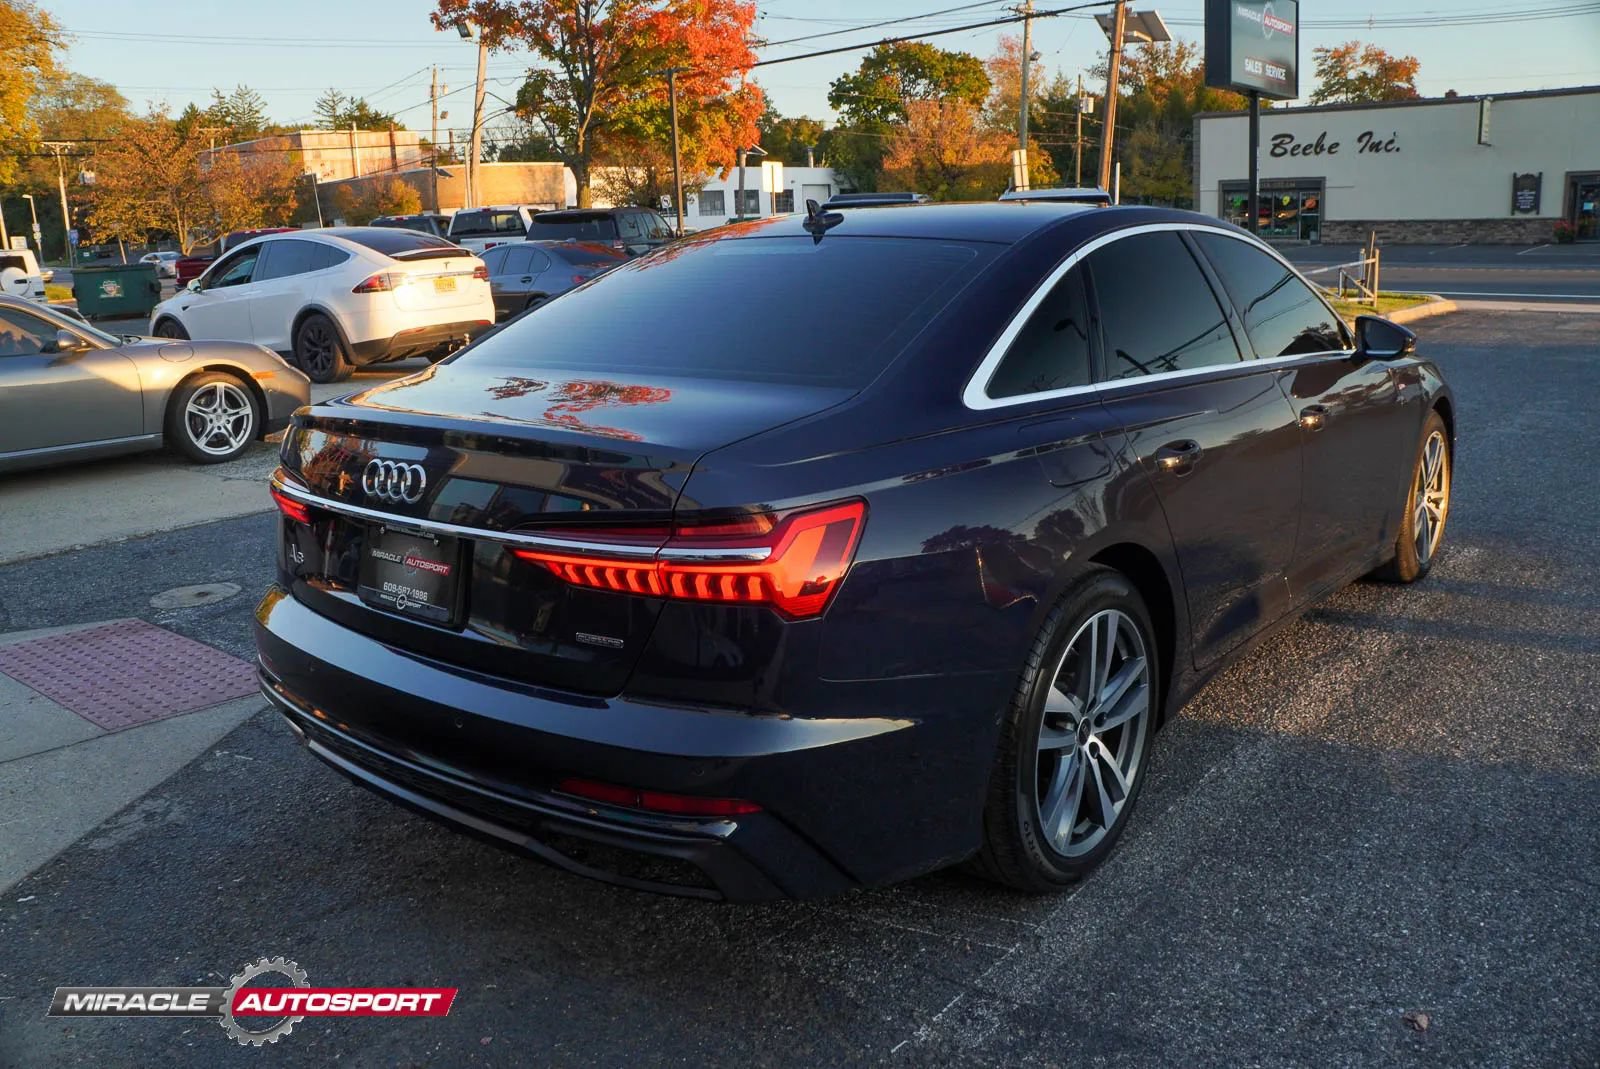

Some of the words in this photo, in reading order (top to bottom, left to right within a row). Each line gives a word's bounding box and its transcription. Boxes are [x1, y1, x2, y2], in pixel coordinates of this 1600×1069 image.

[1264, 15, 1293, 34] AUTOSPORT
[1245, 58, 1263, 75] SALES
[1265, 64, 1286, 80] SERVICE
[1270, 131, 1341, 158] Beebe
[371, 550, 402, 563] MIRACLE
[405, 558, 450, 573] AUTOSPORT
